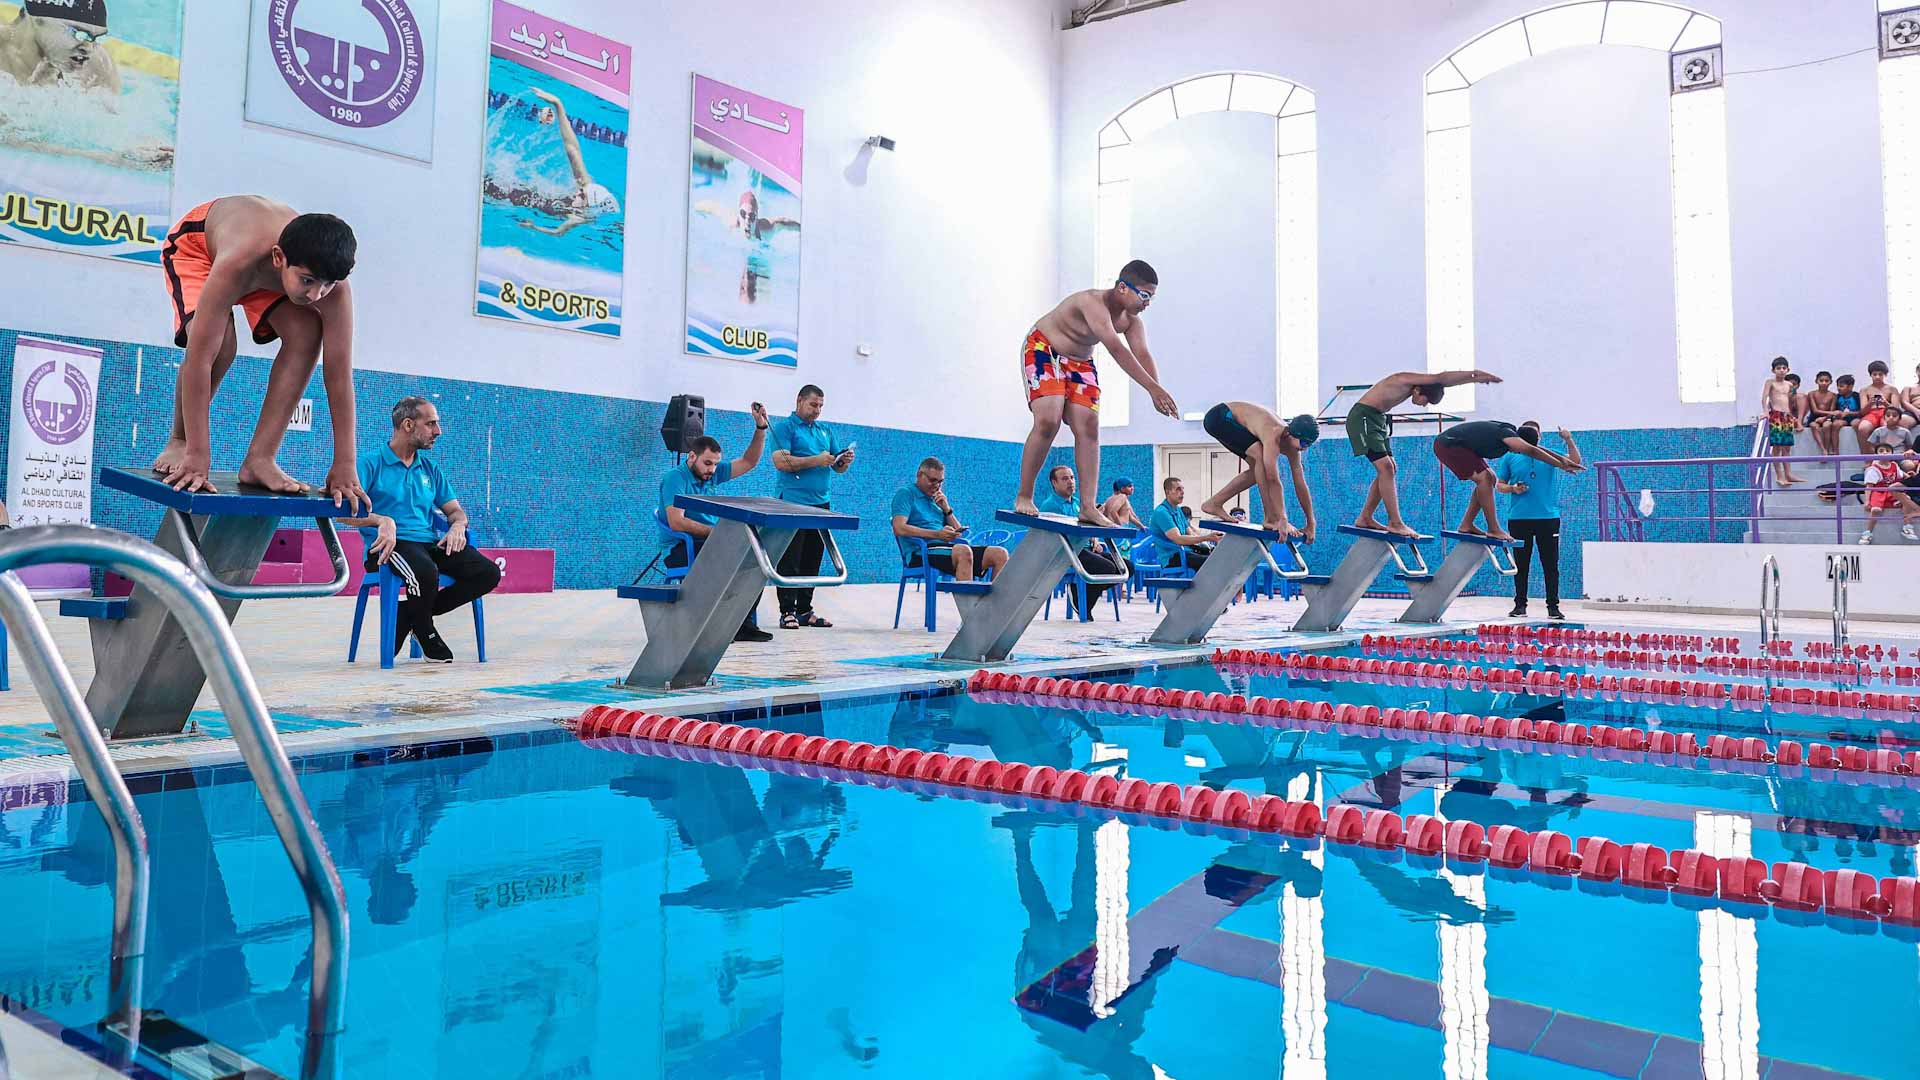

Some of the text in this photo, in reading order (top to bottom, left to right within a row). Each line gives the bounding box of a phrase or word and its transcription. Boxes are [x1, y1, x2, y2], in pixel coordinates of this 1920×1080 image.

[400, 20, 418, 57] Cultural
[509, 23, 620, 75] الذيد
[407, 58, 419, 66] &
[399, 67, 418, 95] Sports
[387, 92, 406, 112] Club
[329, 105, 362, 124] 1980
[710, 98, 790, 134] نادي
[501, 282, 608, 320] & SPORTS
[723, 326, 767, 349] CLUB
[56, 468, 86, 484] الثقافي
[21, 487, 86, 499] AL DHAID CULTURAL
[22, 499, 83, 510] AND SPORTS CLUB
